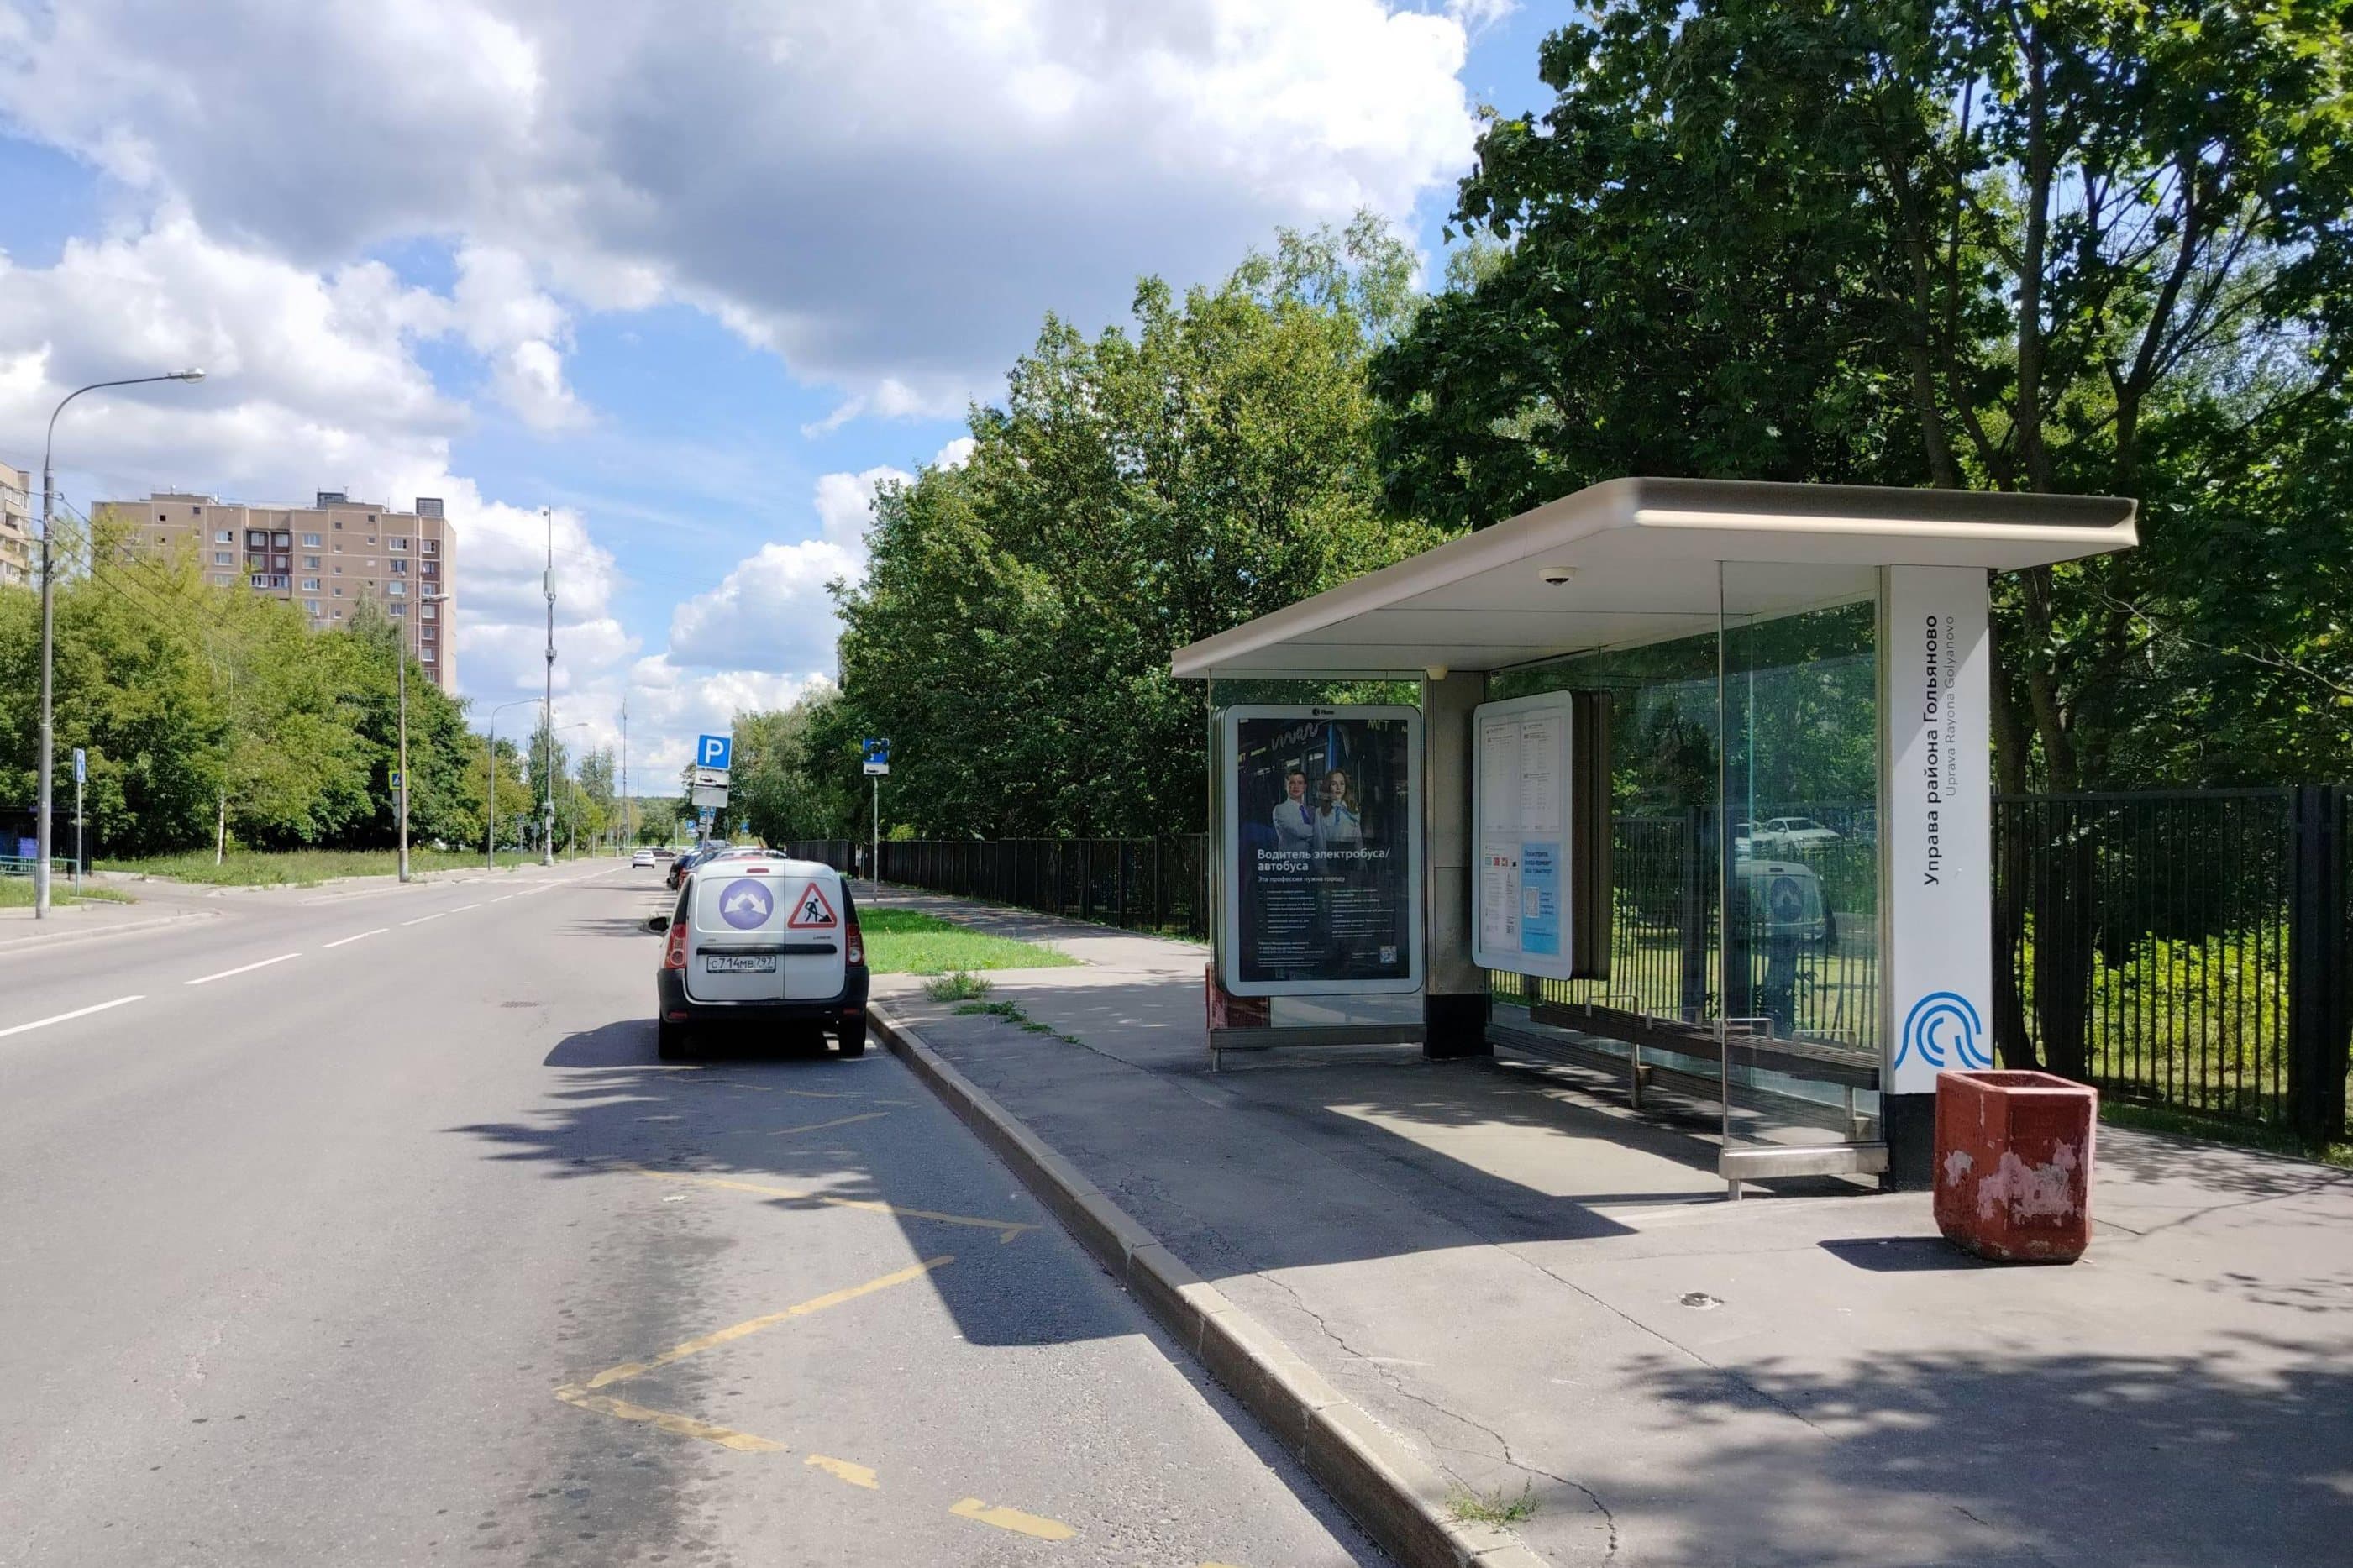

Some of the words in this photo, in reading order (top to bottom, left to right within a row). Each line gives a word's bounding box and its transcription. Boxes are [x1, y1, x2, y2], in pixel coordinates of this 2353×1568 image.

[1923, 616, 1938, 722] Гольяново
[1944, 616, 1956, 689] Golyanovo
[1945, 693, 1957, 743] Rayona
[705, 738, 724, 764] P
[1923, 730, 1941, 804] района
[1946, 747, 1958, 796] Uprava
[1258, 849, 1311, 861] Водитель
[1314, 847, 1391, 861] электробуса/
[1258, 860, 1309, 873] автобуса
[1924, 810, 1941, 886] Управа
